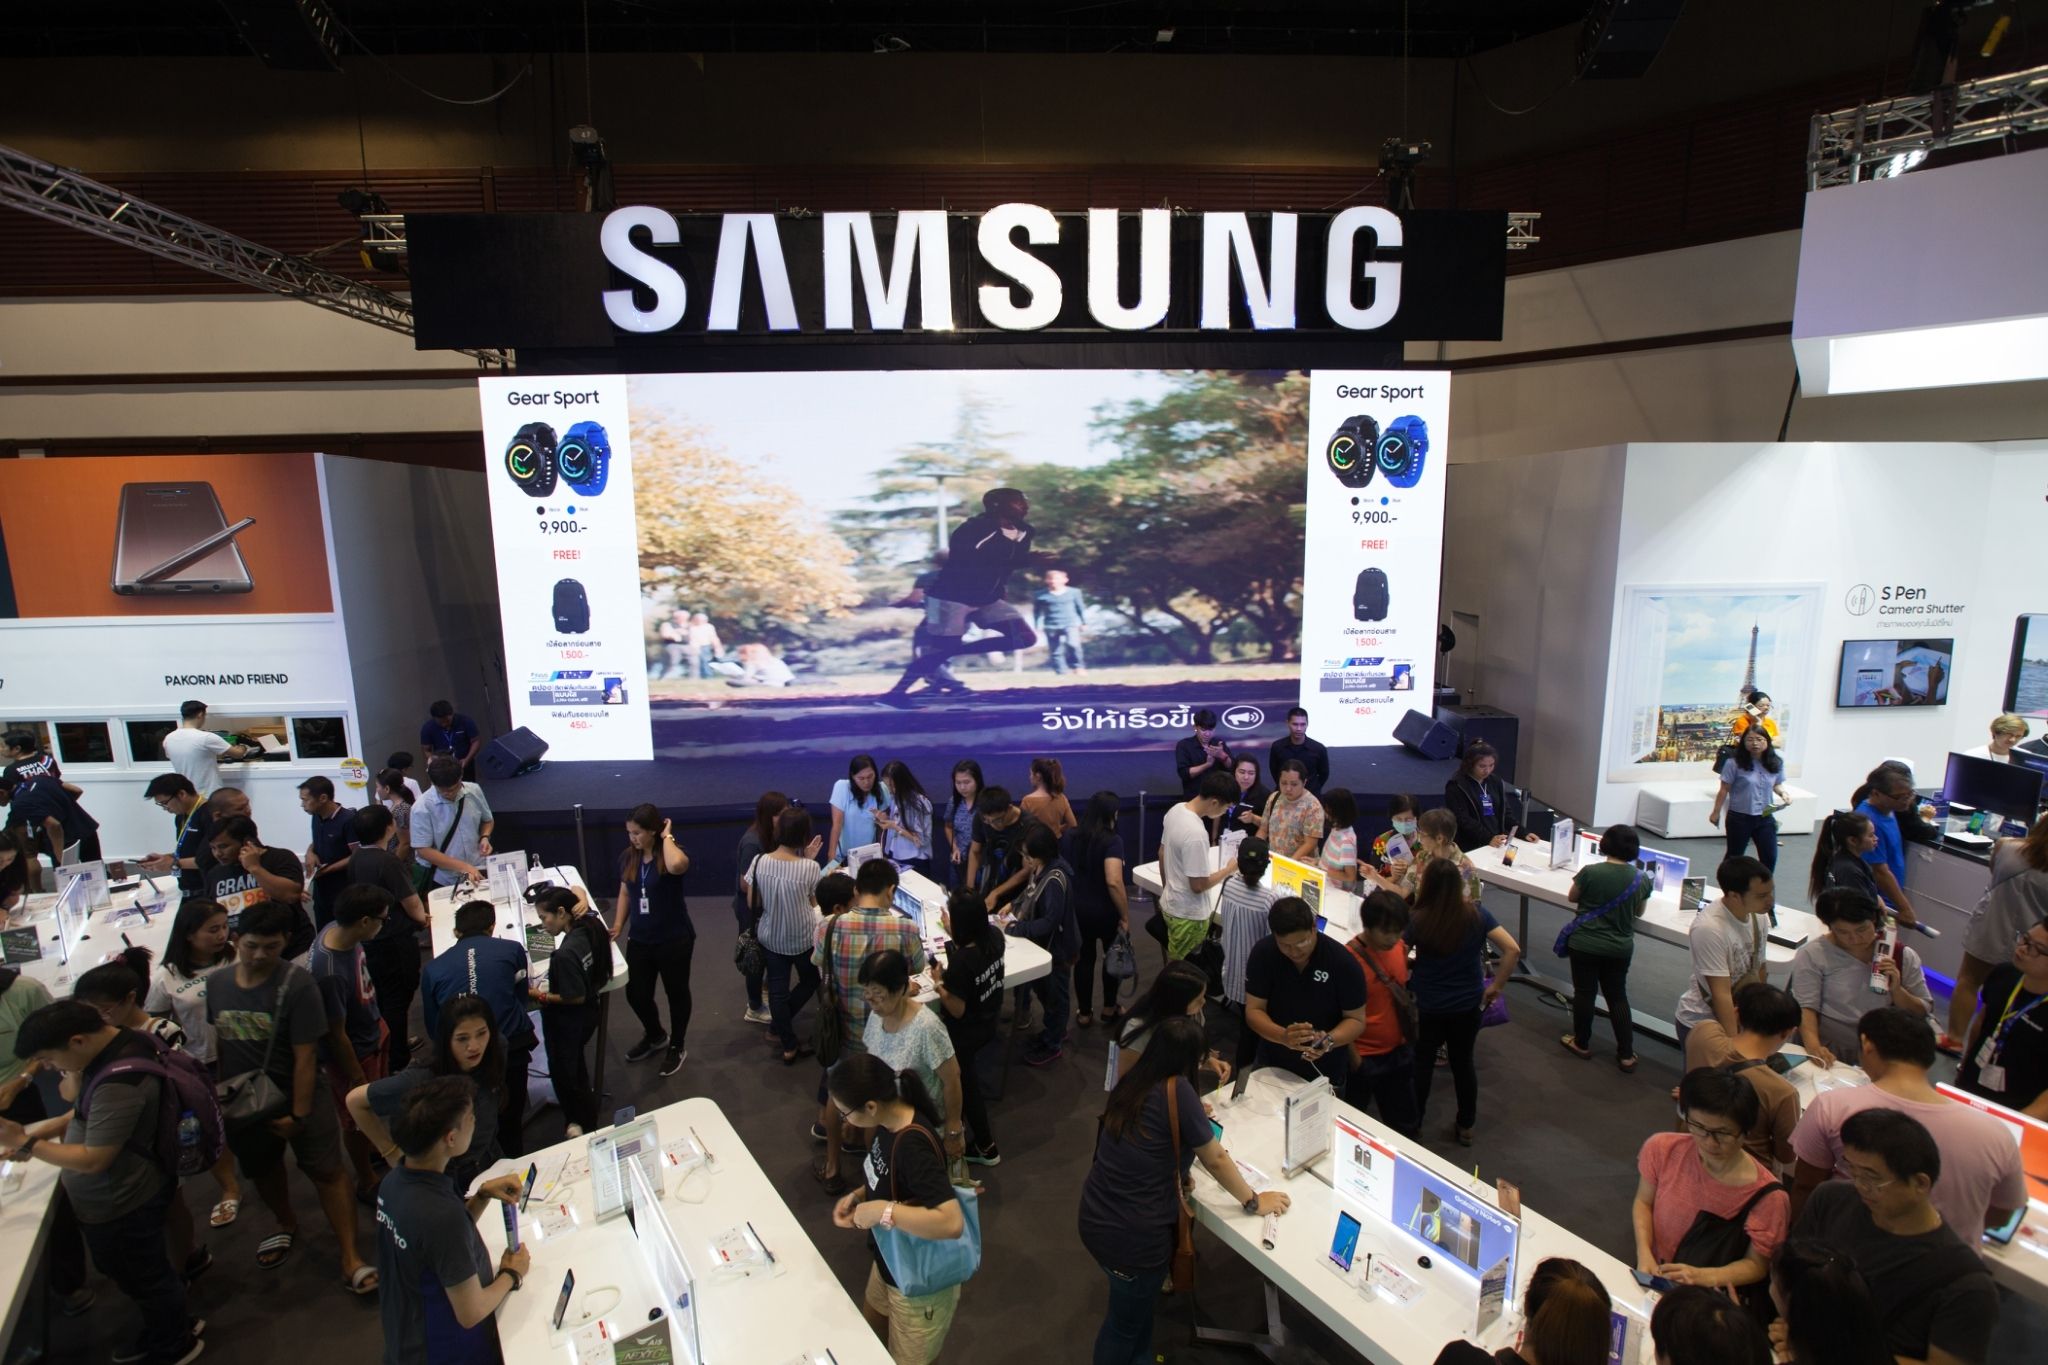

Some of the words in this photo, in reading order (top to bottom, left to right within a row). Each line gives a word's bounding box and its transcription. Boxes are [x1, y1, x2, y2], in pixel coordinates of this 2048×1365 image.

[601, 203, 1403, 333] SAMSUNG
[507, 391, 550, 406] Gear
[553, 390, 600, 409] Sport
[1336, 384, 1378, 399] Gear
[1380, 385, 1424, 403] Sport
[1352, 510, 1398, 525] 9,900.-
[539, 520, 588, 535] 9,900.-
[1361, 539, 1388, 550] FREE!
[553, 549, 581, 560] FREE!
[1880, 586, 1891, 600] S
[1895, 586, 1927, 600] Pen
[1879, 605, 1924, 615] Camera
[1926, 604, 1966, 614] Shutter
[164, 675, 215, 686] PAKORN
[218, 674, 245, 685] AND
[247, 673, 289, 685] FRIEND
[1042, 704, 1196, 731] วิ่งให้เร็วขึ้
[216, 873, 257, 897] GRAN
[1313, 969, 1329, 983] S9
